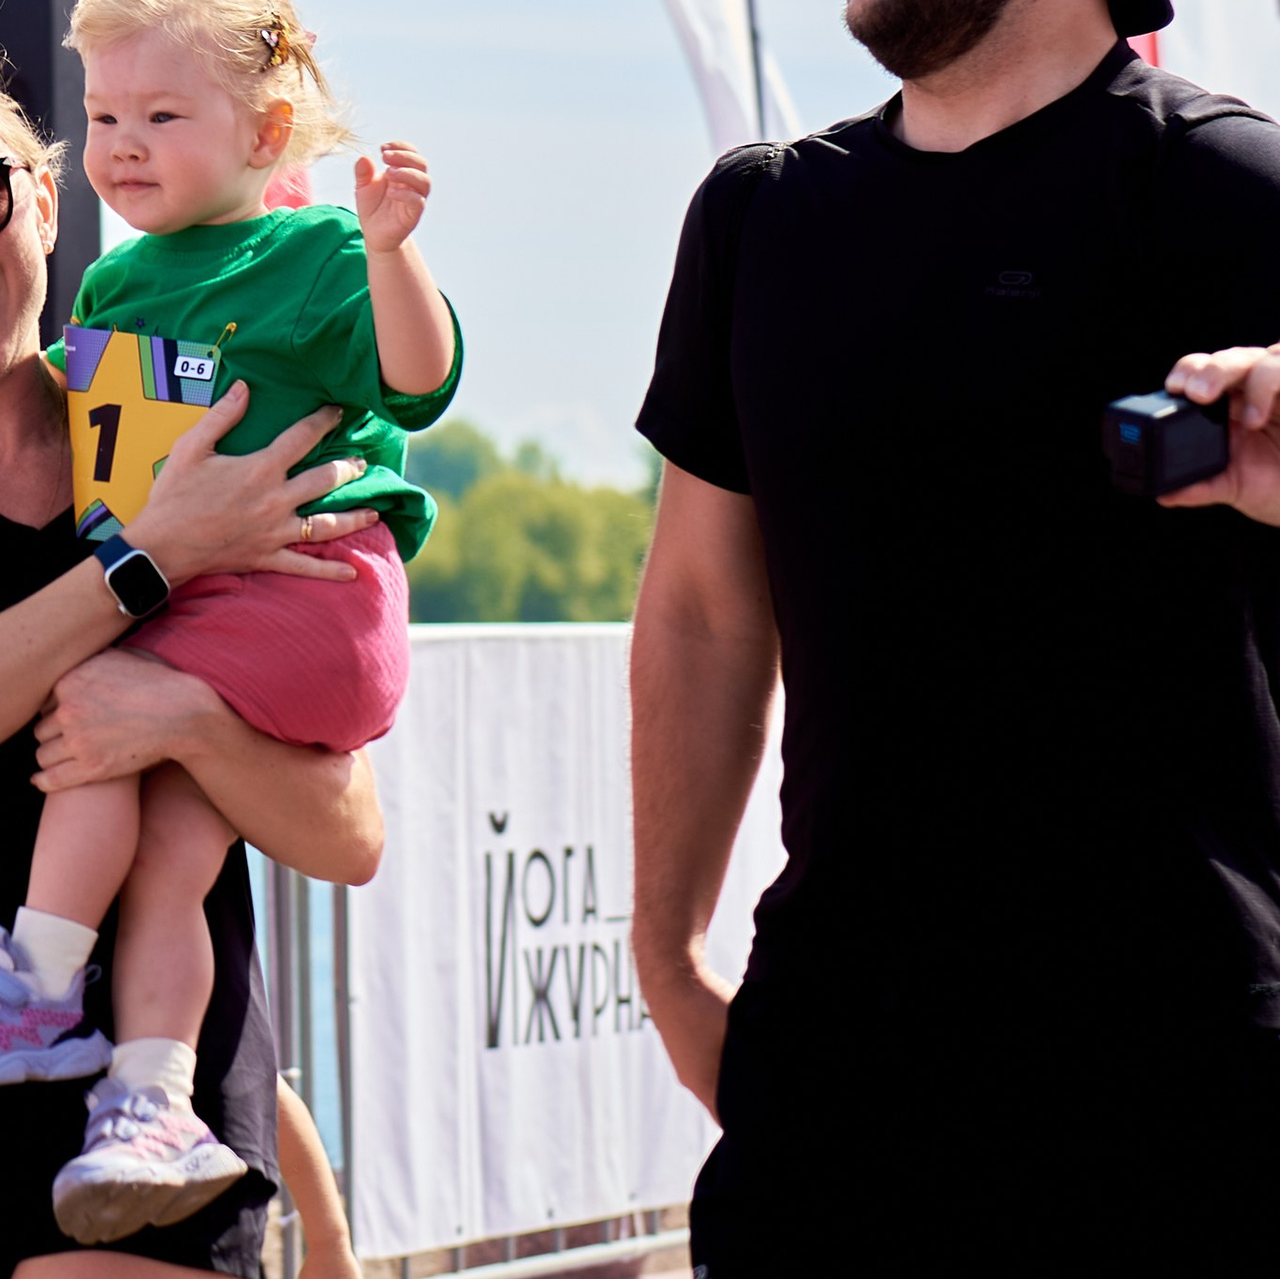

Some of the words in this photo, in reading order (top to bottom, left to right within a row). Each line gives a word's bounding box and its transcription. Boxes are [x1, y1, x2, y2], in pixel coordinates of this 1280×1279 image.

[180, 360, 206, 376] 0-6
[88, 403, 122, 483] 1
[485, 811, 597, 1049] ЙОГА
